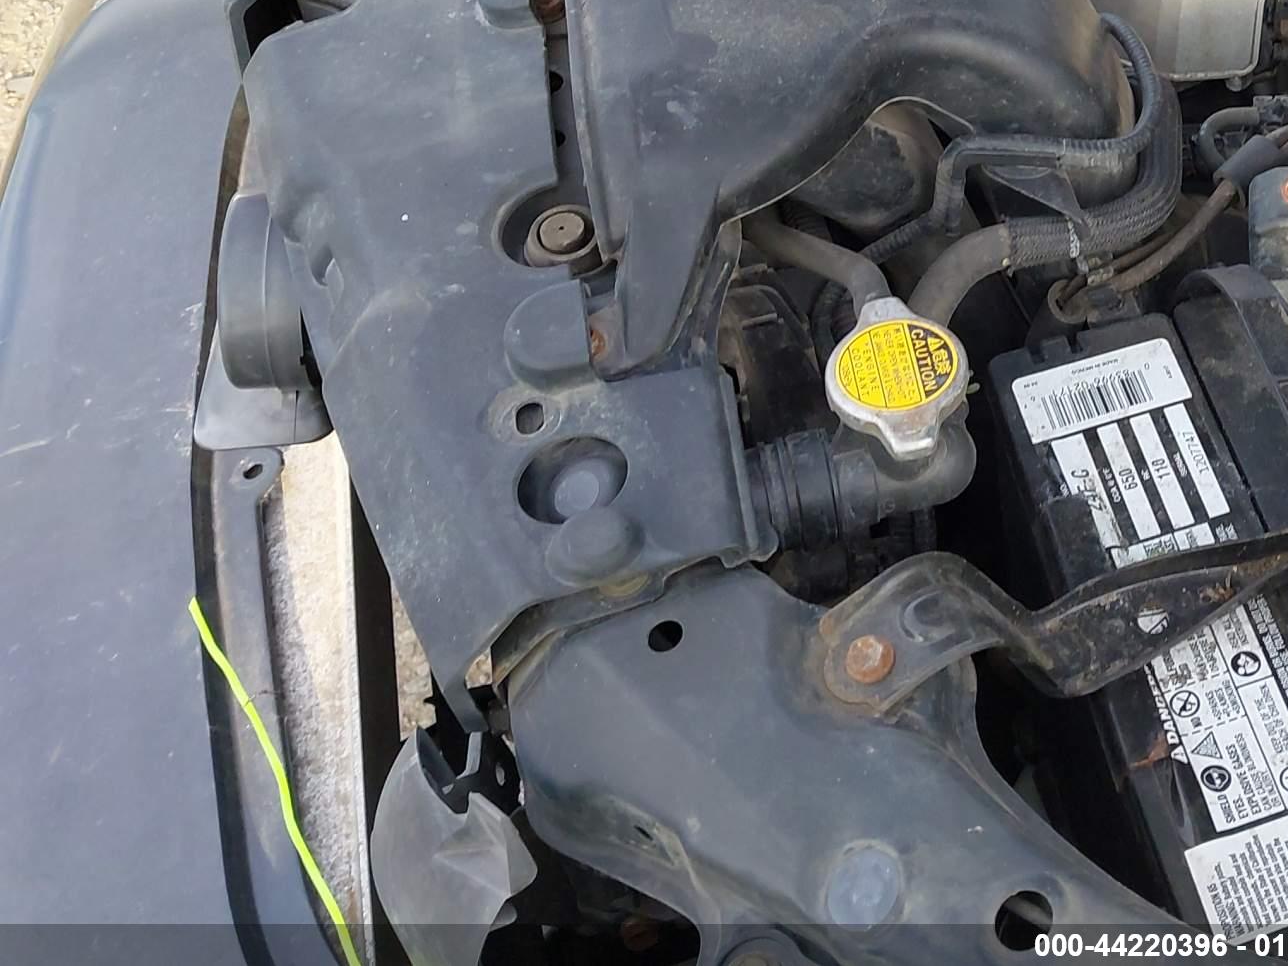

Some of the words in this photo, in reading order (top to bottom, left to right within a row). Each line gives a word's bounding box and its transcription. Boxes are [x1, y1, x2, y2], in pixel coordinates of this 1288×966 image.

[909, 327, 938, 391] CAUTION
[1181, 431, 1211, 475] 1207747
[1117, 466, 1138, 492] 650
[1150, 456, 1171, 481] 110
[1253, 695, 1266, 712] THE
[1259, 710, 1270, 721] OF
[1189, 715, 1202, 728] NO
[1263, 720, 1277, 737] OUT
[1272, 716, 1284, 728] OF
[1224, 742, 1243, 770] GASES
[1233, 731, 1257, 772] BLINDNESS
[1270, 735, 1285, 755] KEEP
[1235, 768, 1262, 816] EXPLOSIVE
[1248, 770, 1266, 796] CAUSE
[1215, 792, 1236, 825] SHIELD
[1230, 793, 1250, 820] EYES.
[1258, 794, 1273, 812] CAN
[1269, 795, 1282, 808] OR
